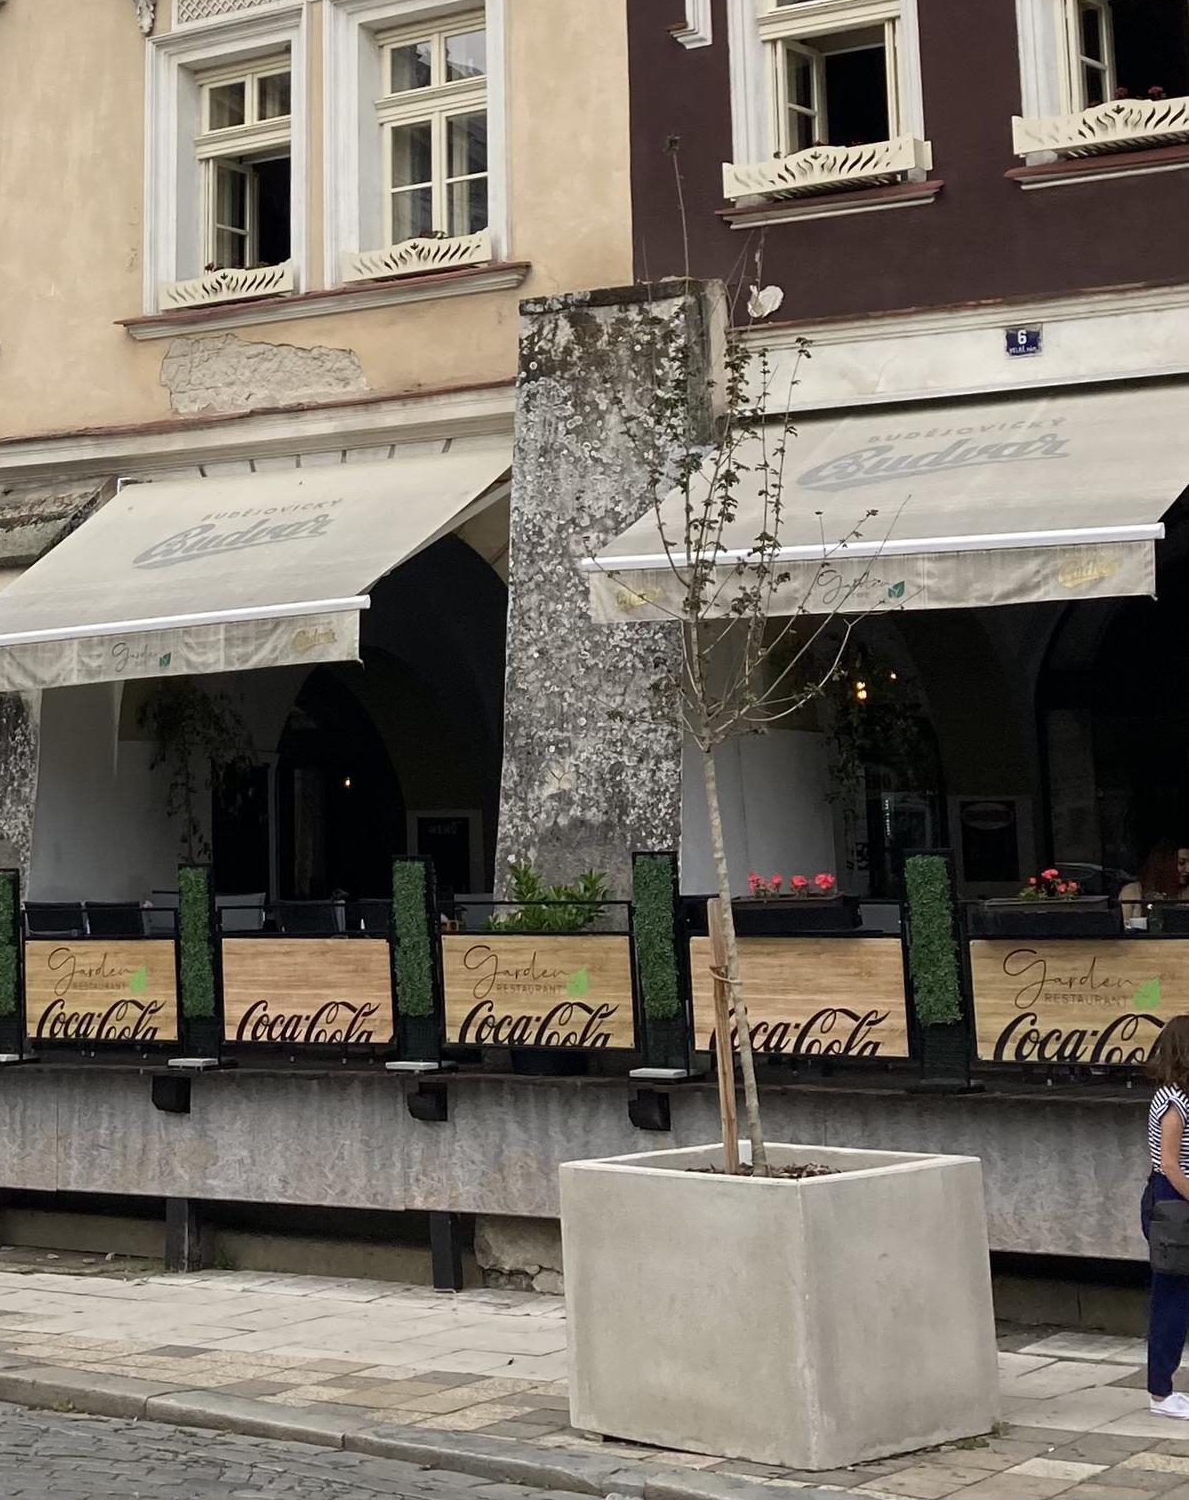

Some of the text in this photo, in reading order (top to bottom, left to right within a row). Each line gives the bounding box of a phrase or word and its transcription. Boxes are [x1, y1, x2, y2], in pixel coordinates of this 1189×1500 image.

[1017, 329, 1027, 345] 6
[796, 433, 1071, 492] Budvar
[132, 513, 335, 569] Budvar
[496, 983, 563, 996] RESTAURANT
[1002, 948, 1139, 1009] Garden
[1044, 993, 1129, 1008] RESTAURANT
